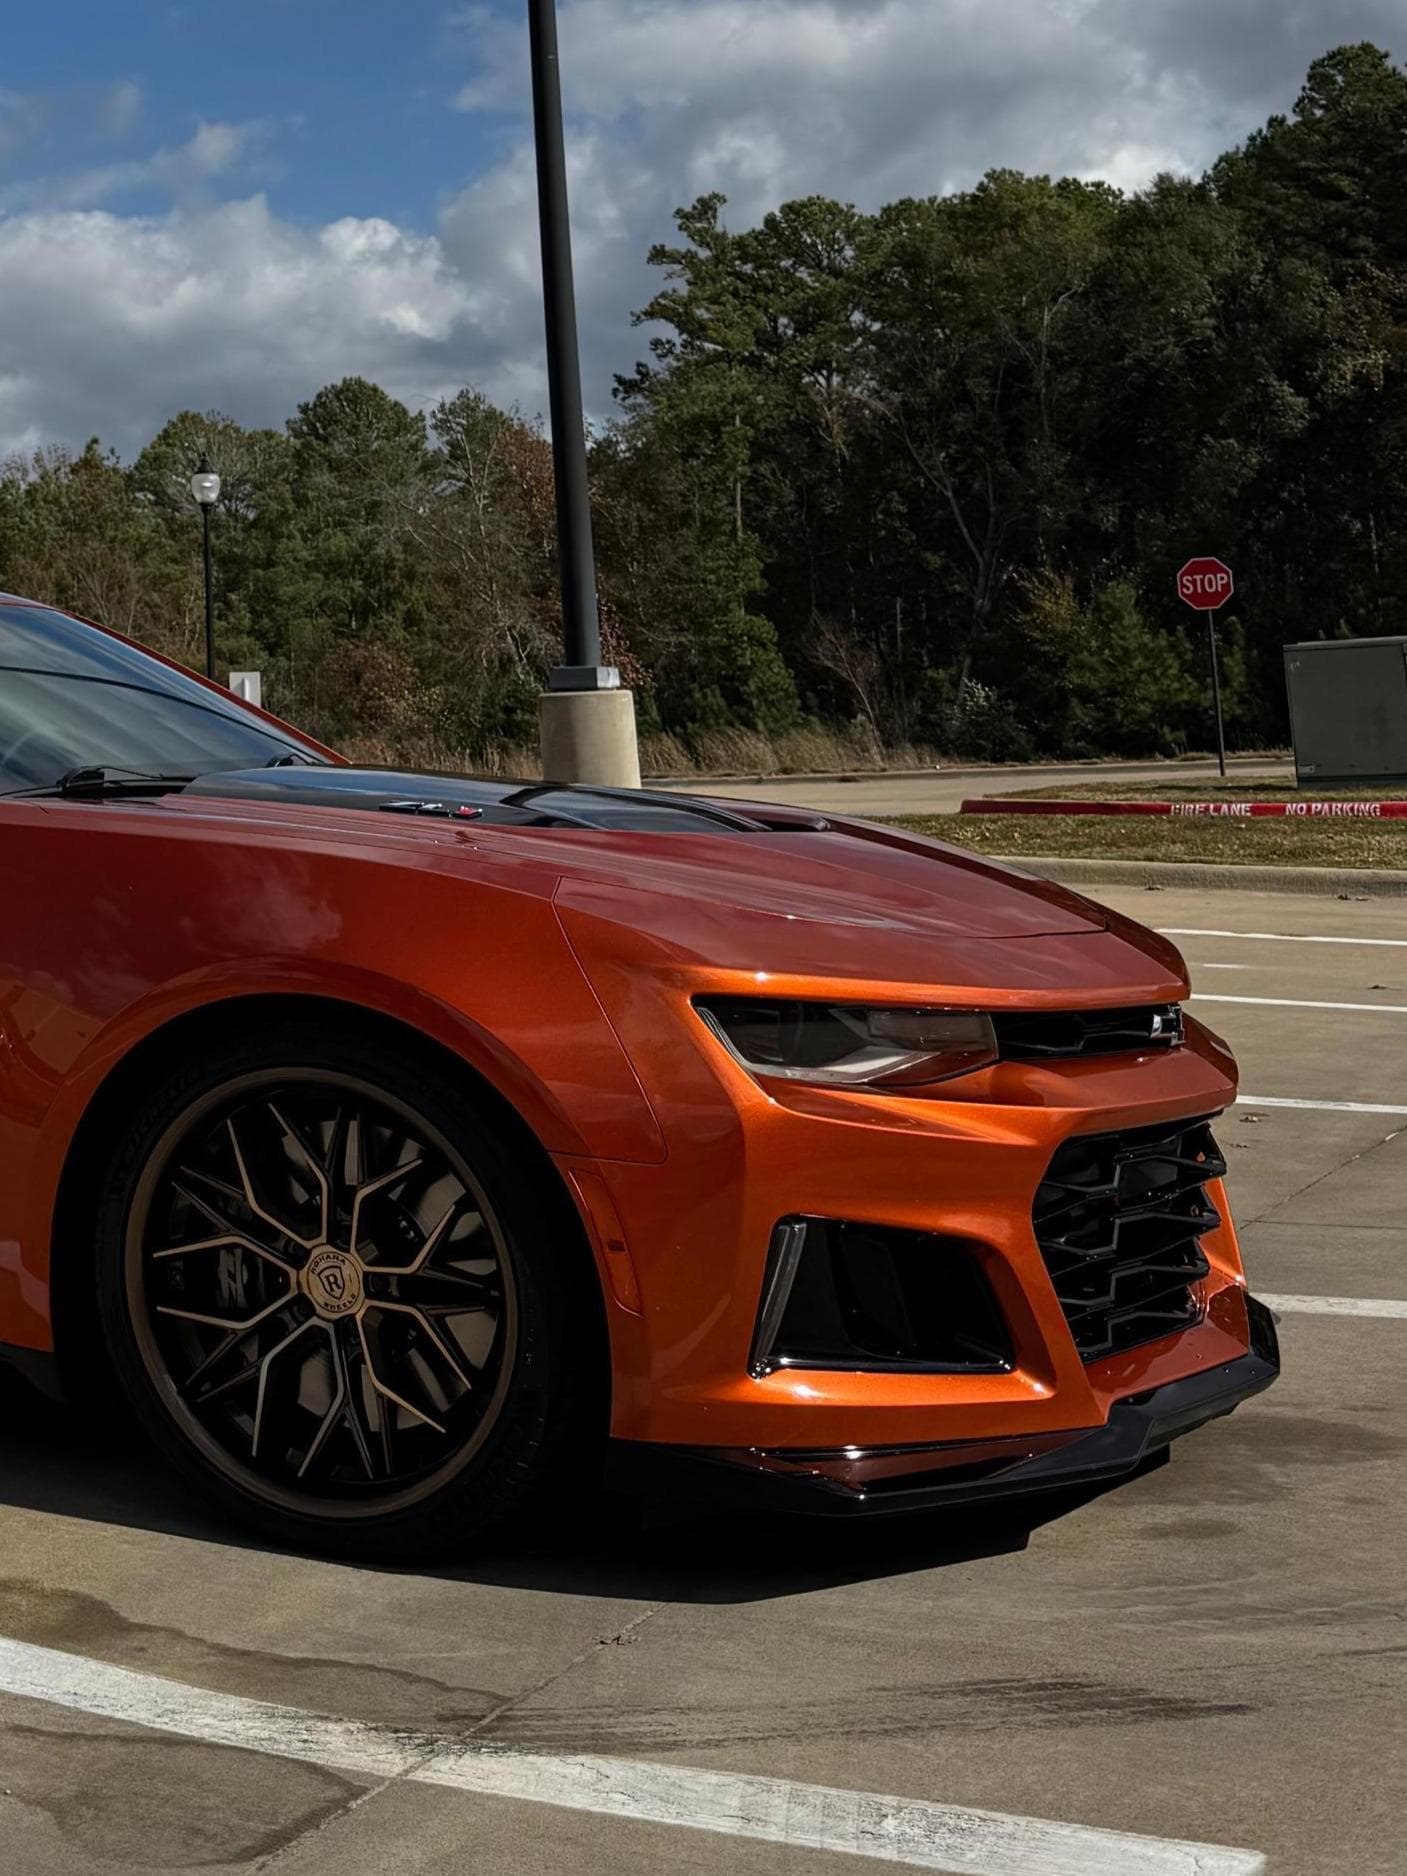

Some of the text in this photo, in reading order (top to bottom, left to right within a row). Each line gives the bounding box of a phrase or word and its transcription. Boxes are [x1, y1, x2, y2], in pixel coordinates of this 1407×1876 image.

[1182, 573, 1228, 594] STOP
[1171, 802, 1381, 817] FIRE LANE NO PARKING
[325, 1273, 342, 1292] R
